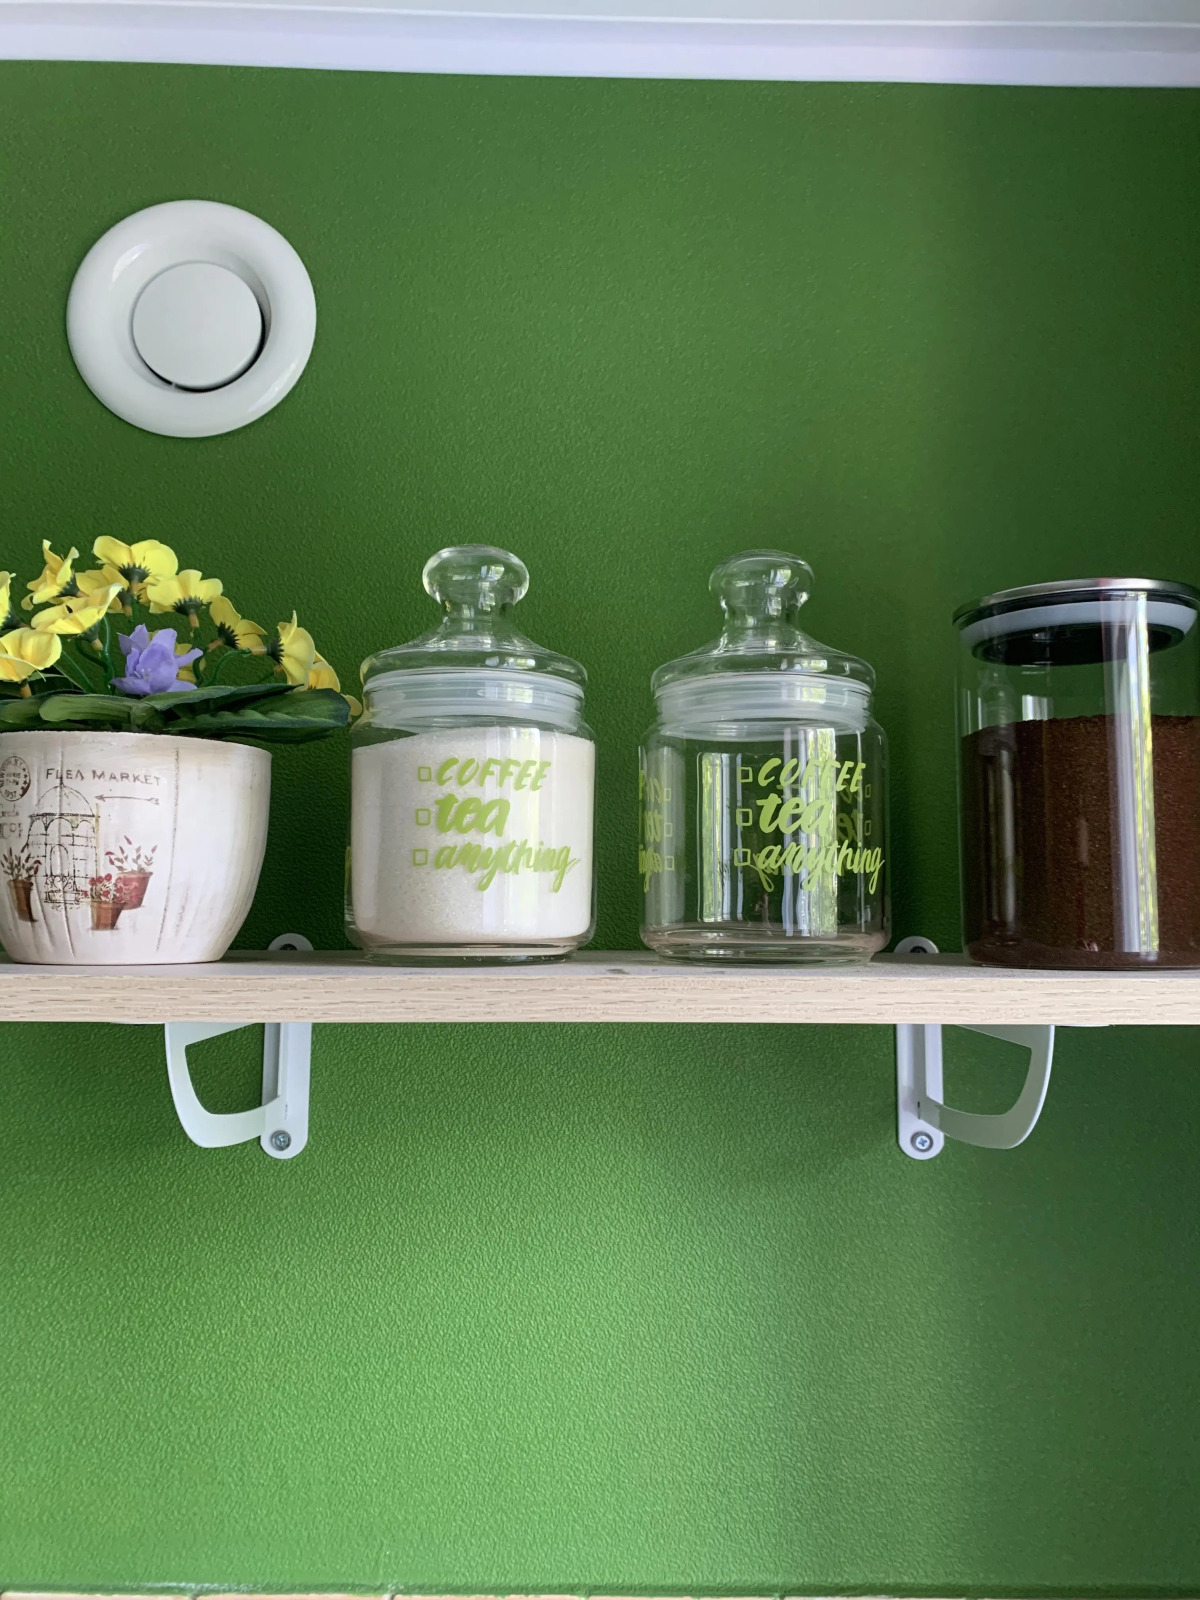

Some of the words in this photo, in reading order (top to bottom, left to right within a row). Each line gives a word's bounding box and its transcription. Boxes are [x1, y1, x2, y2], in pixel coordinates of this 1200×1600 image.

[45, 768, 85, 780] FLEA
[92, 769, 161, 786] MARKET
[436, 757, 552, 791] COFFEE
[757, 757, 866, 792] COFFEE
[434, 793, 511, 837] tea
[756, 793, 833, 838] tea
[434, 839, 581, 893] anything
[757, 840, 885, 895] anything
